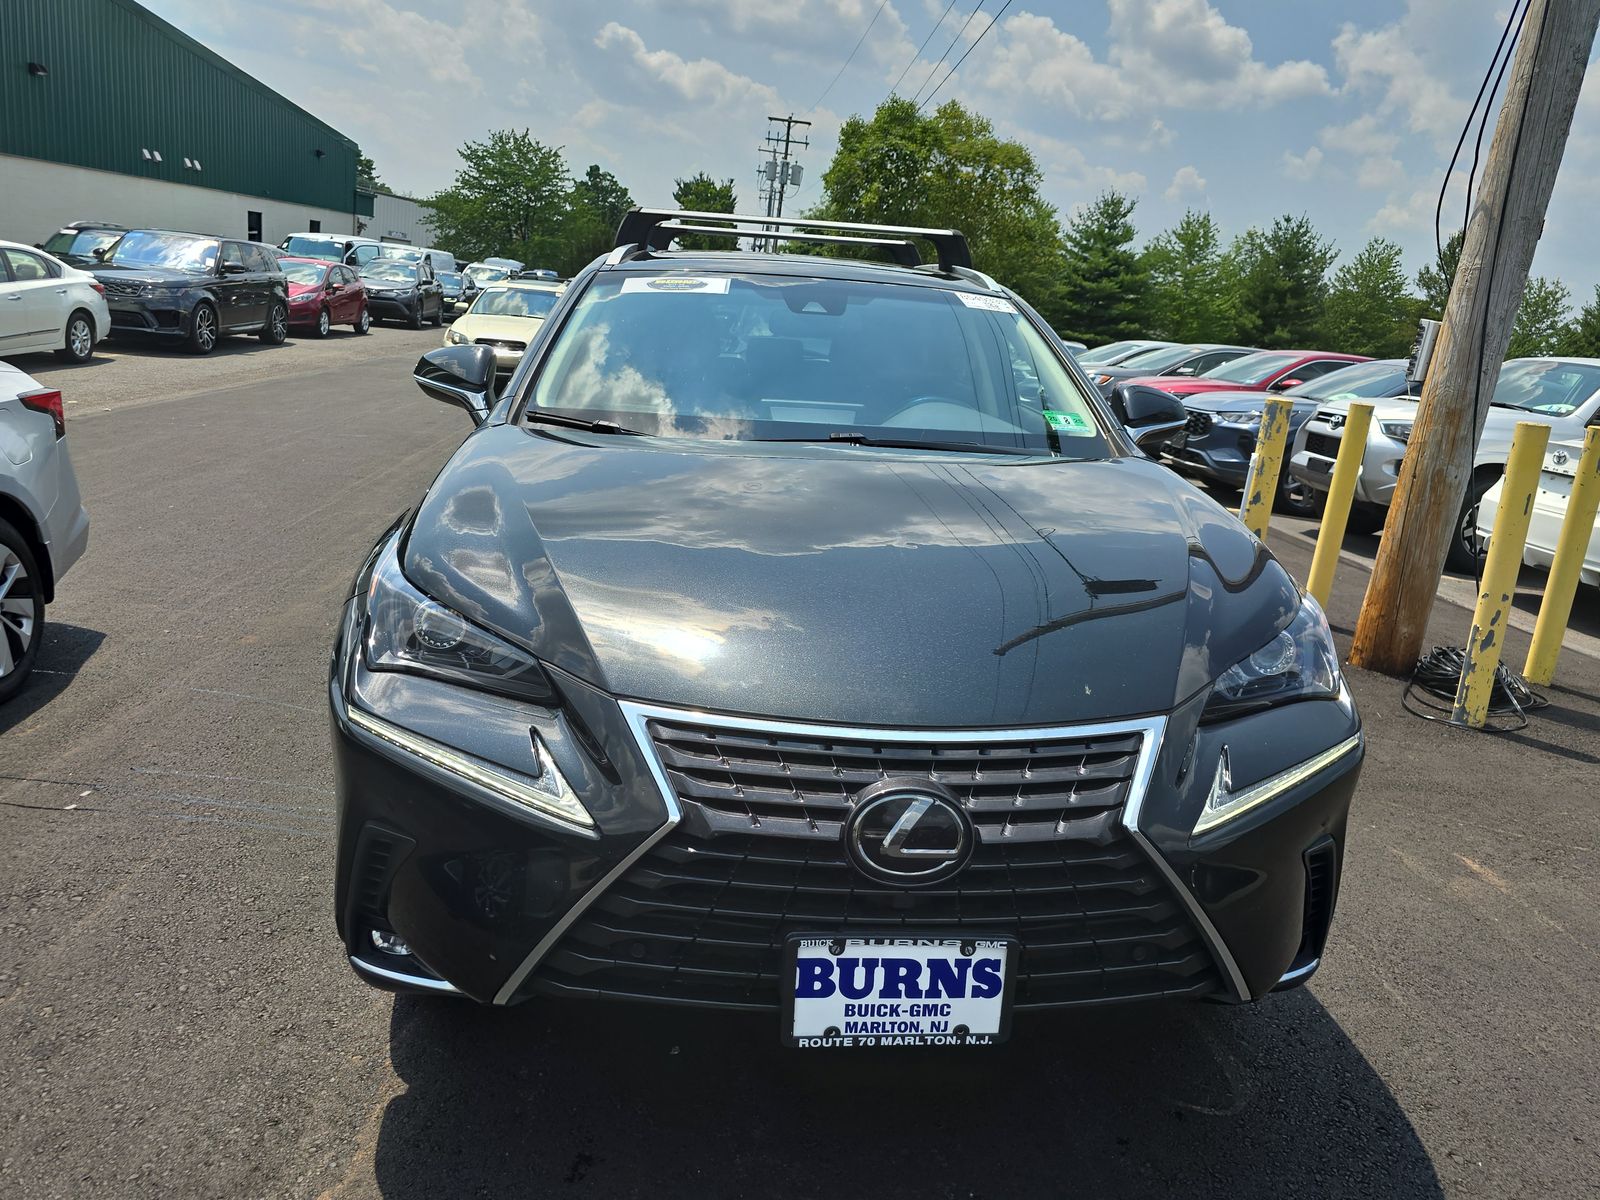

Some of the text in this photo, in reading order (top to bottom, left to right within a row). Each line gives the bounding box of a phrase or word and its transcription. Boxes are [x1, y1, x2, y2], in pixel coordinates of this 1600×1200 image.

[800, 938, 1008, 949] BUICK BURNS GMC
[795, 957, 1003, 1000] BURNS
[844, 1003, 952, 1017] BUICK-GMC
[844, 1021, 949, 1034] MARLTON, NJ
[798, 1035, 993, 1048] ROUTE 70 MARLTON, N.J.
